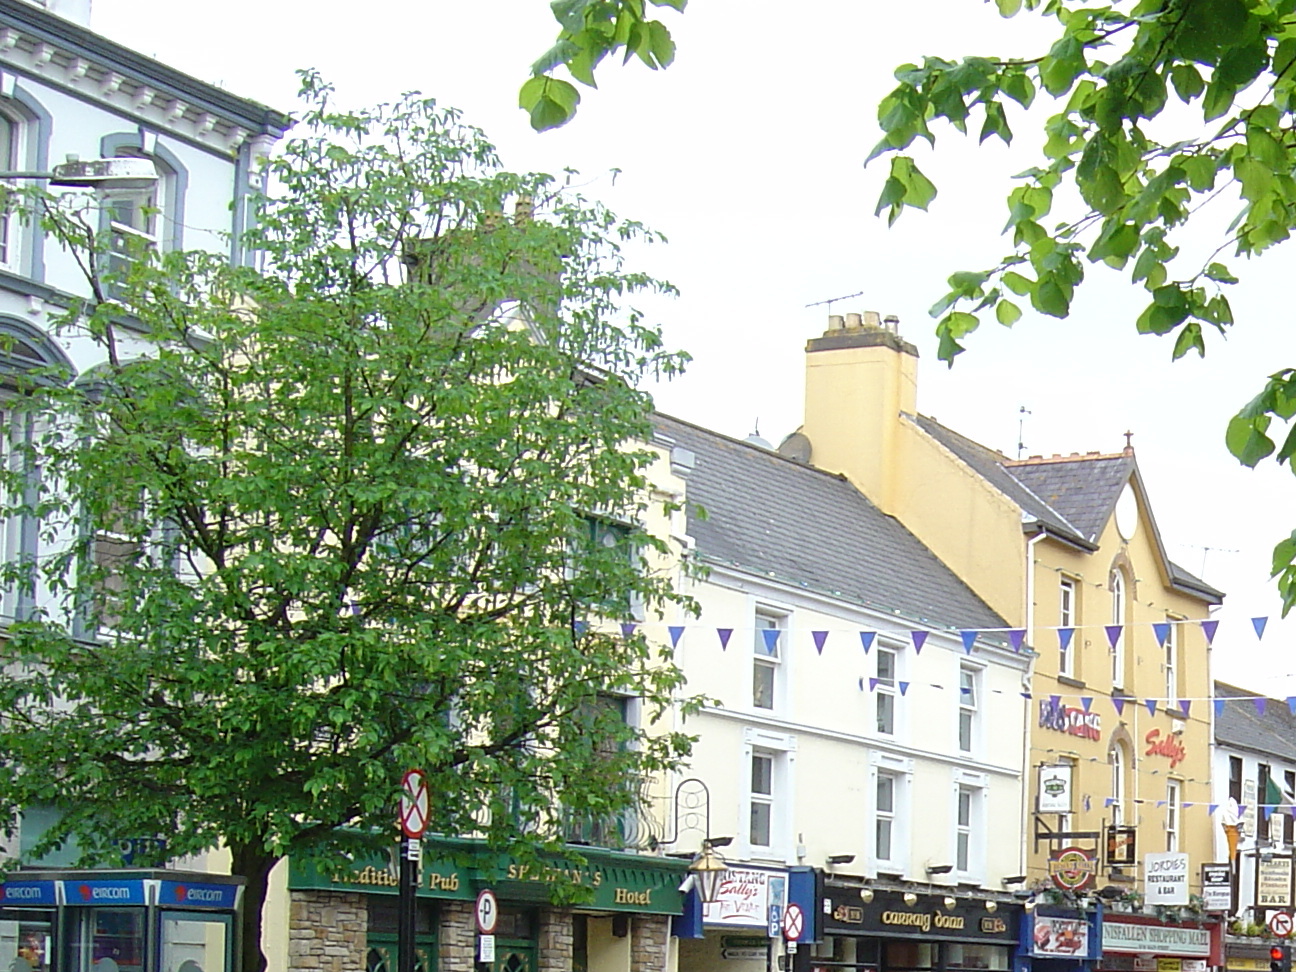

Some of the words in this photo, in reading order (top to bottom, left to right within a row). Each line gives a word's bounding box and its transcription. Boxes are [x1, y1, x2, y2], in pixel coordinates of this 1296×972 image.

[1145, 728, 1186, 769] Sally's
[430, 872, 459, 891] Pub
[719, 870, 765, 885] USTANG
[1147, 874, 1185, 883] RESTAURANT
[5, 886, 41, 899] eircom
[92, 886, 130, 899] eircom
[187, 887, 222, 902] eircom
[615, 887, 652, 905] Hotel
[719, 880, 758, 900] Sally's
[1163, 886, 1175, 894] BAR
[1260, 895, 1287, 903] BAR
[1104, 924, 1148, 942] NISFALLEN
[1149, 928, 1187, 944] SHOPPING
